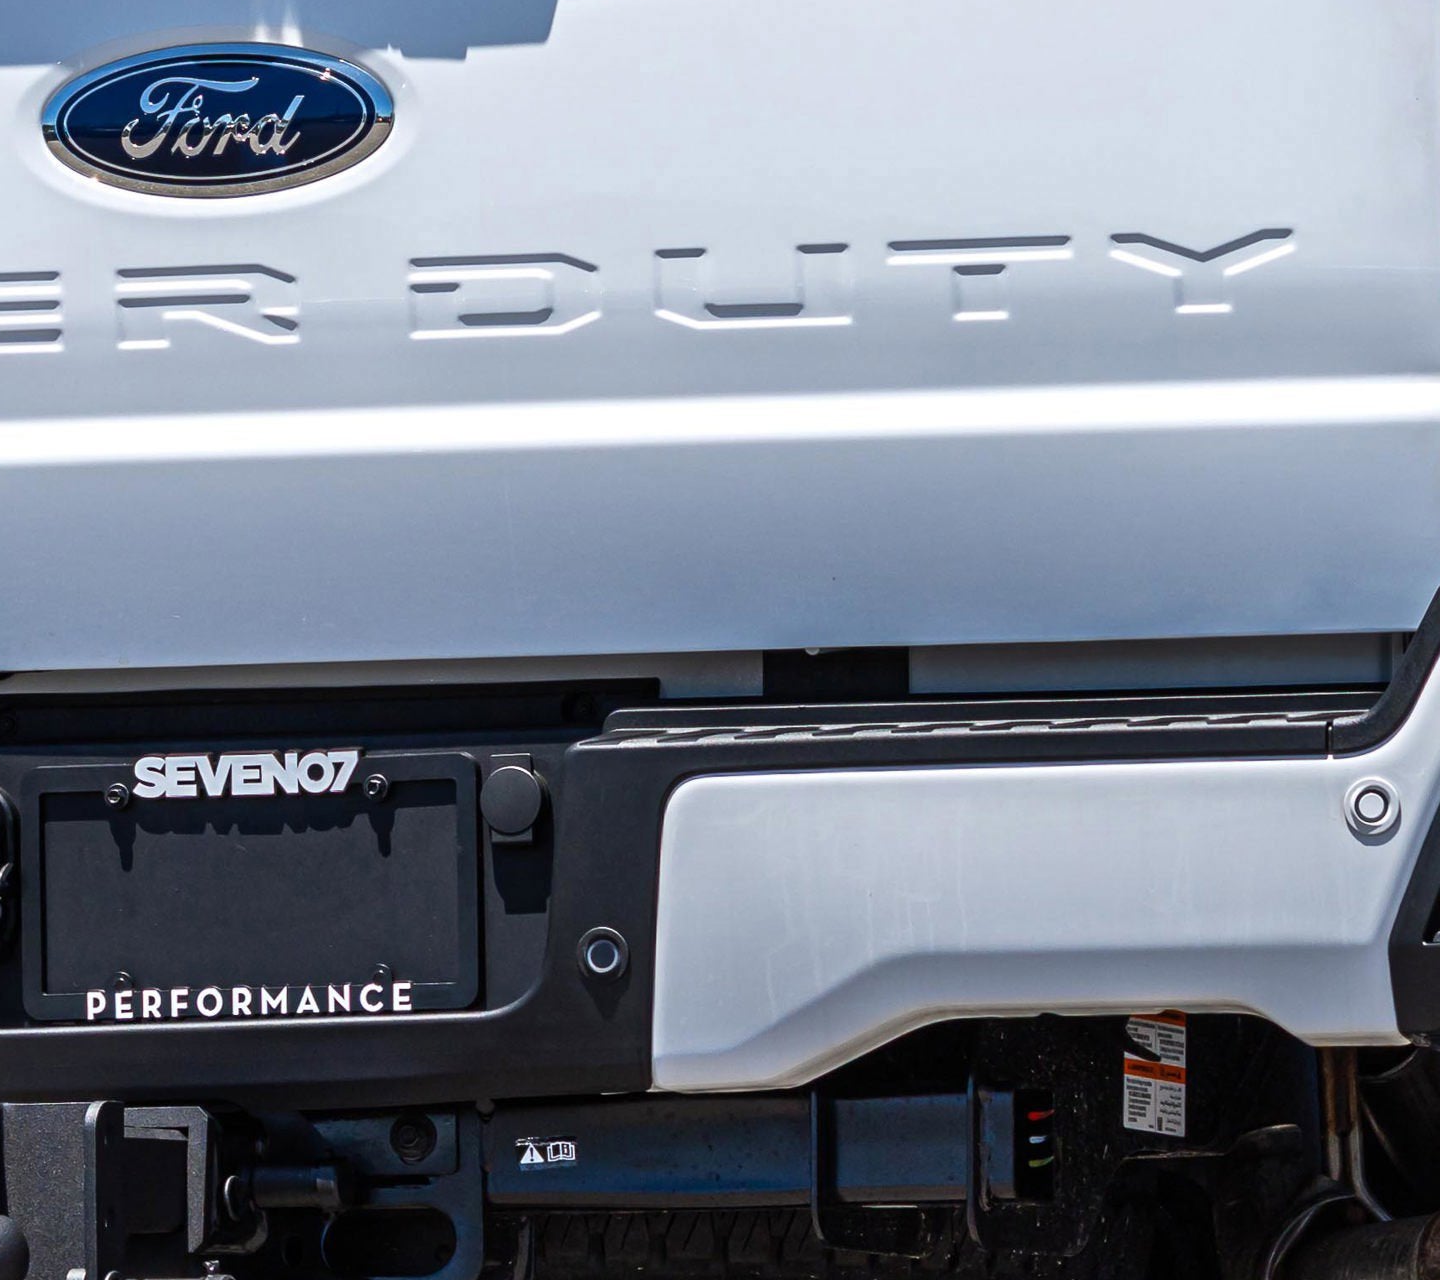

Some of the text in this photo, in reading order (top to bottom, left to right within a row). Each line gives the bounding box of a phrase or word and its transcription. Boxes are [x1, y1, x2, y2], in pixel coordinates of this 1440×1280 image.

[119, 75, 305, 160] Ford
[407, 226, 1295, 341] DUTY
[86, 981, 414, 1021] PERFORMANCE
